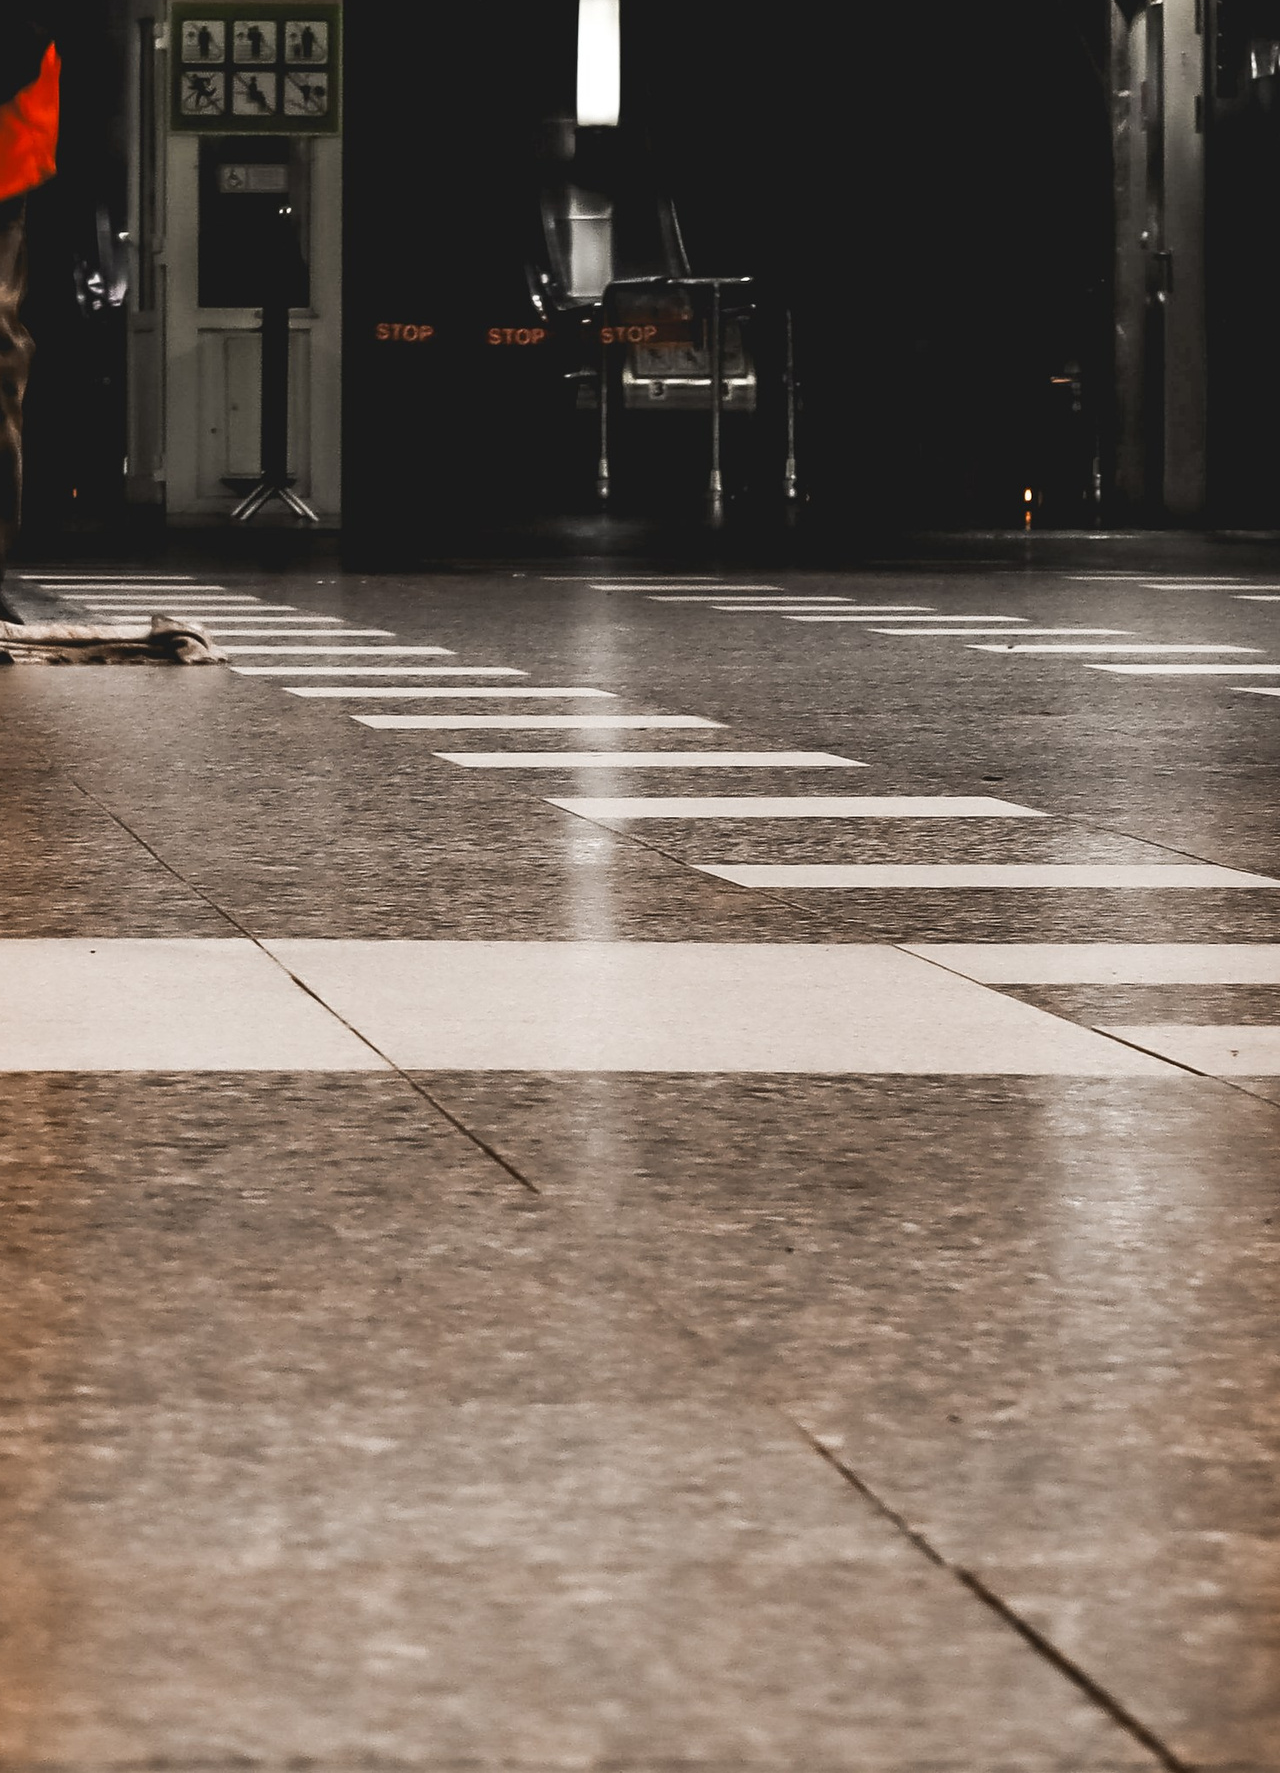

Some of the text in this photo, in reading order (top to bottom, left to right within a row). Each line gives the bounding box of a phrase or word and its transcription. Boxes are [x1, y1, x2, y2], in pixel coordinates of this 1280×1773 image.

[376, 322, 435, 342] STOP
[487, 327, 546, 346] STOP
[600, 325, 658, 345] STOP
